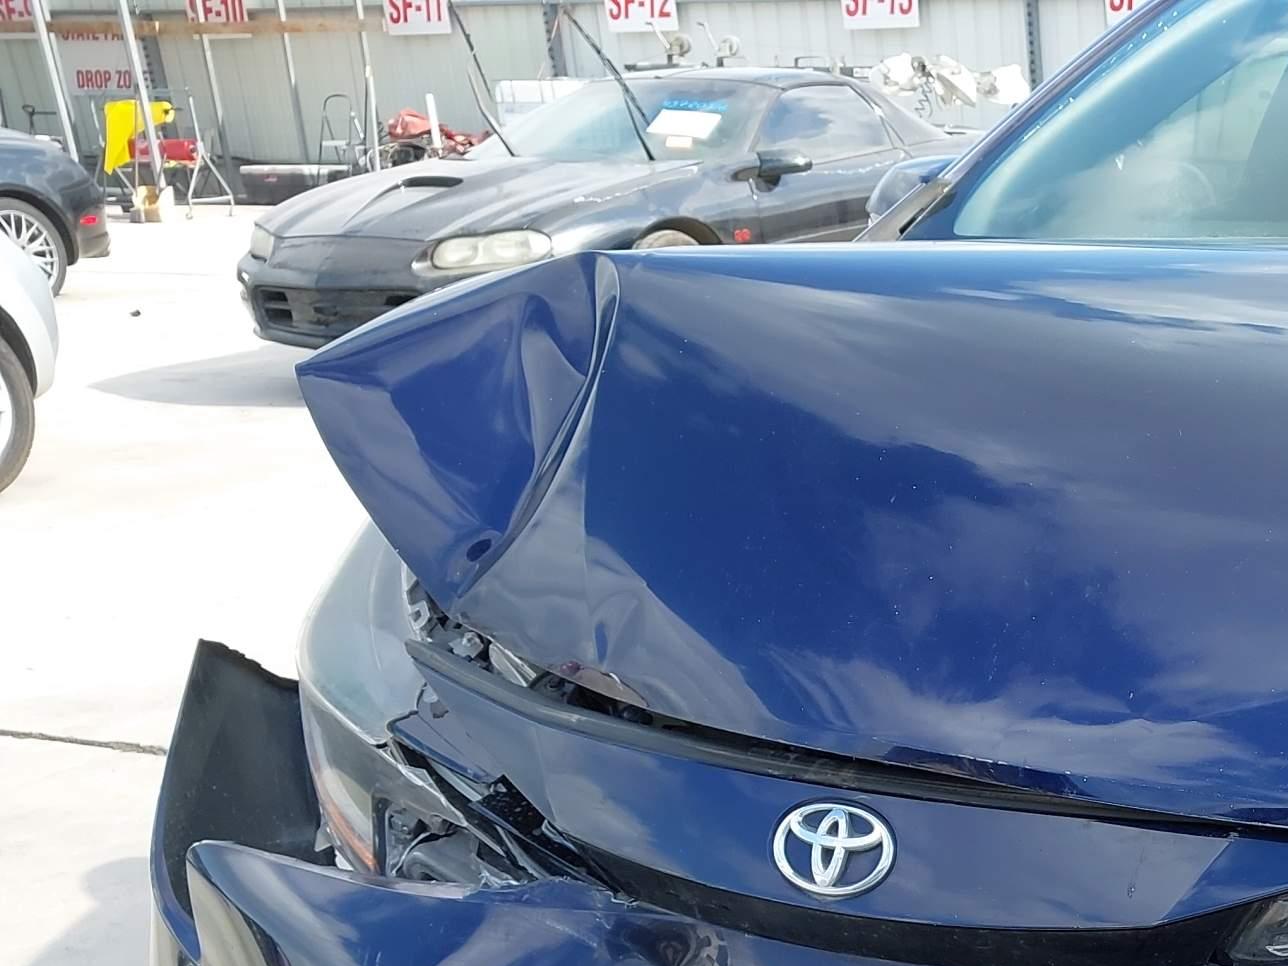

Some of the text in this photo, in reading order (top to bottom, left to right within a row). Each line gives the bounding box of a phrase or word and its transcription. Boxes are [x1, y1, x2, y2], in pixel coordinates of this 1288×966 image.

[388, 0, 443, 24] SF-11
[609, 0, 672, 20] SF-12
[76, 69, 112, 89] DROP
